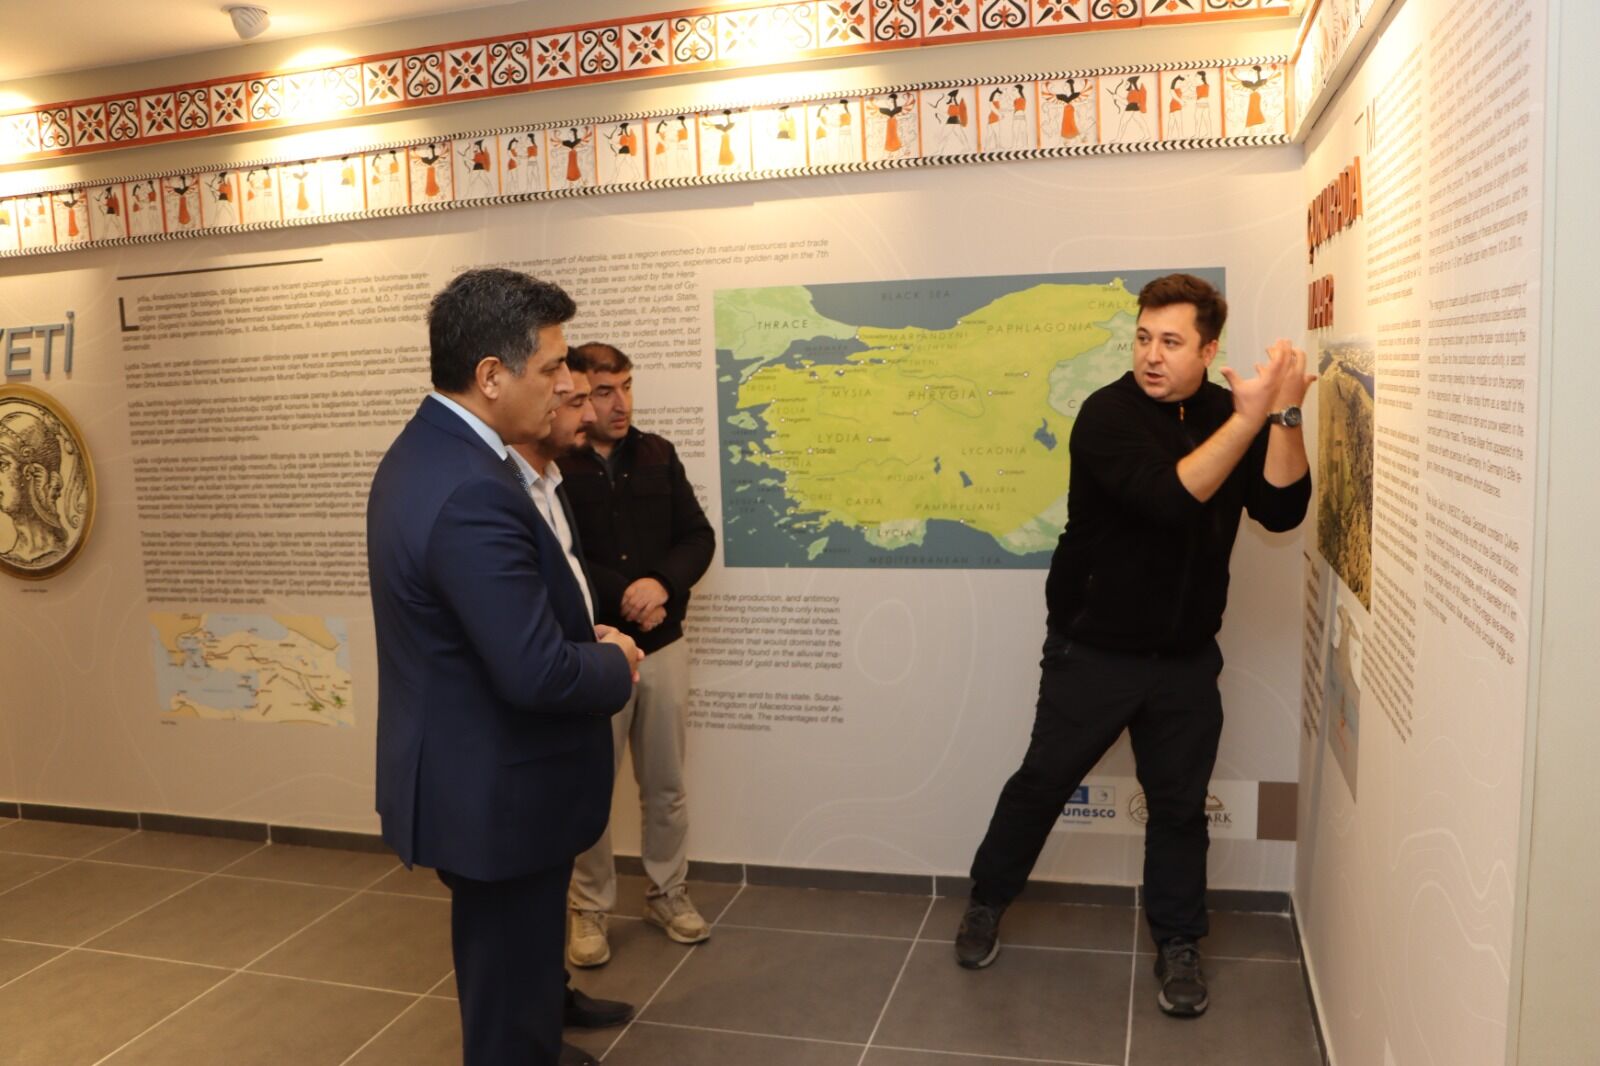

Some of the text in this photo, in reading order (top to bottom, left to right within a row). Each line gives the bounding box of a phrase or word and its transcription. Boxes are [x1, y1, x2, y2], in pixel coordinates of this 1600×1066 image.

[629, 273, 648, 281] ruled
[650, 273, 659, 281] by
[758, 320, 809, 330] THRACE
[988, 322, 1092, 334] PAPHLAGONIA
[0, 311, 75, 376] ETİ
[634, 350, 702, 360] country extended
[832, 389, 872, 398] MYSIA
[908, 388, 976, 400] PHRYGIA
[676, 417, 704, 425] directly
[685, 438, 705, 447] Road
[818, 434, 860, 444] LYDIA
[961, 447, 1026, 456] LYCAONIA
[846, 498, 882, 506] CARIA
[877, 529, 913, 538] LYCIA
[1062, 808, 1116, 818] unesco
